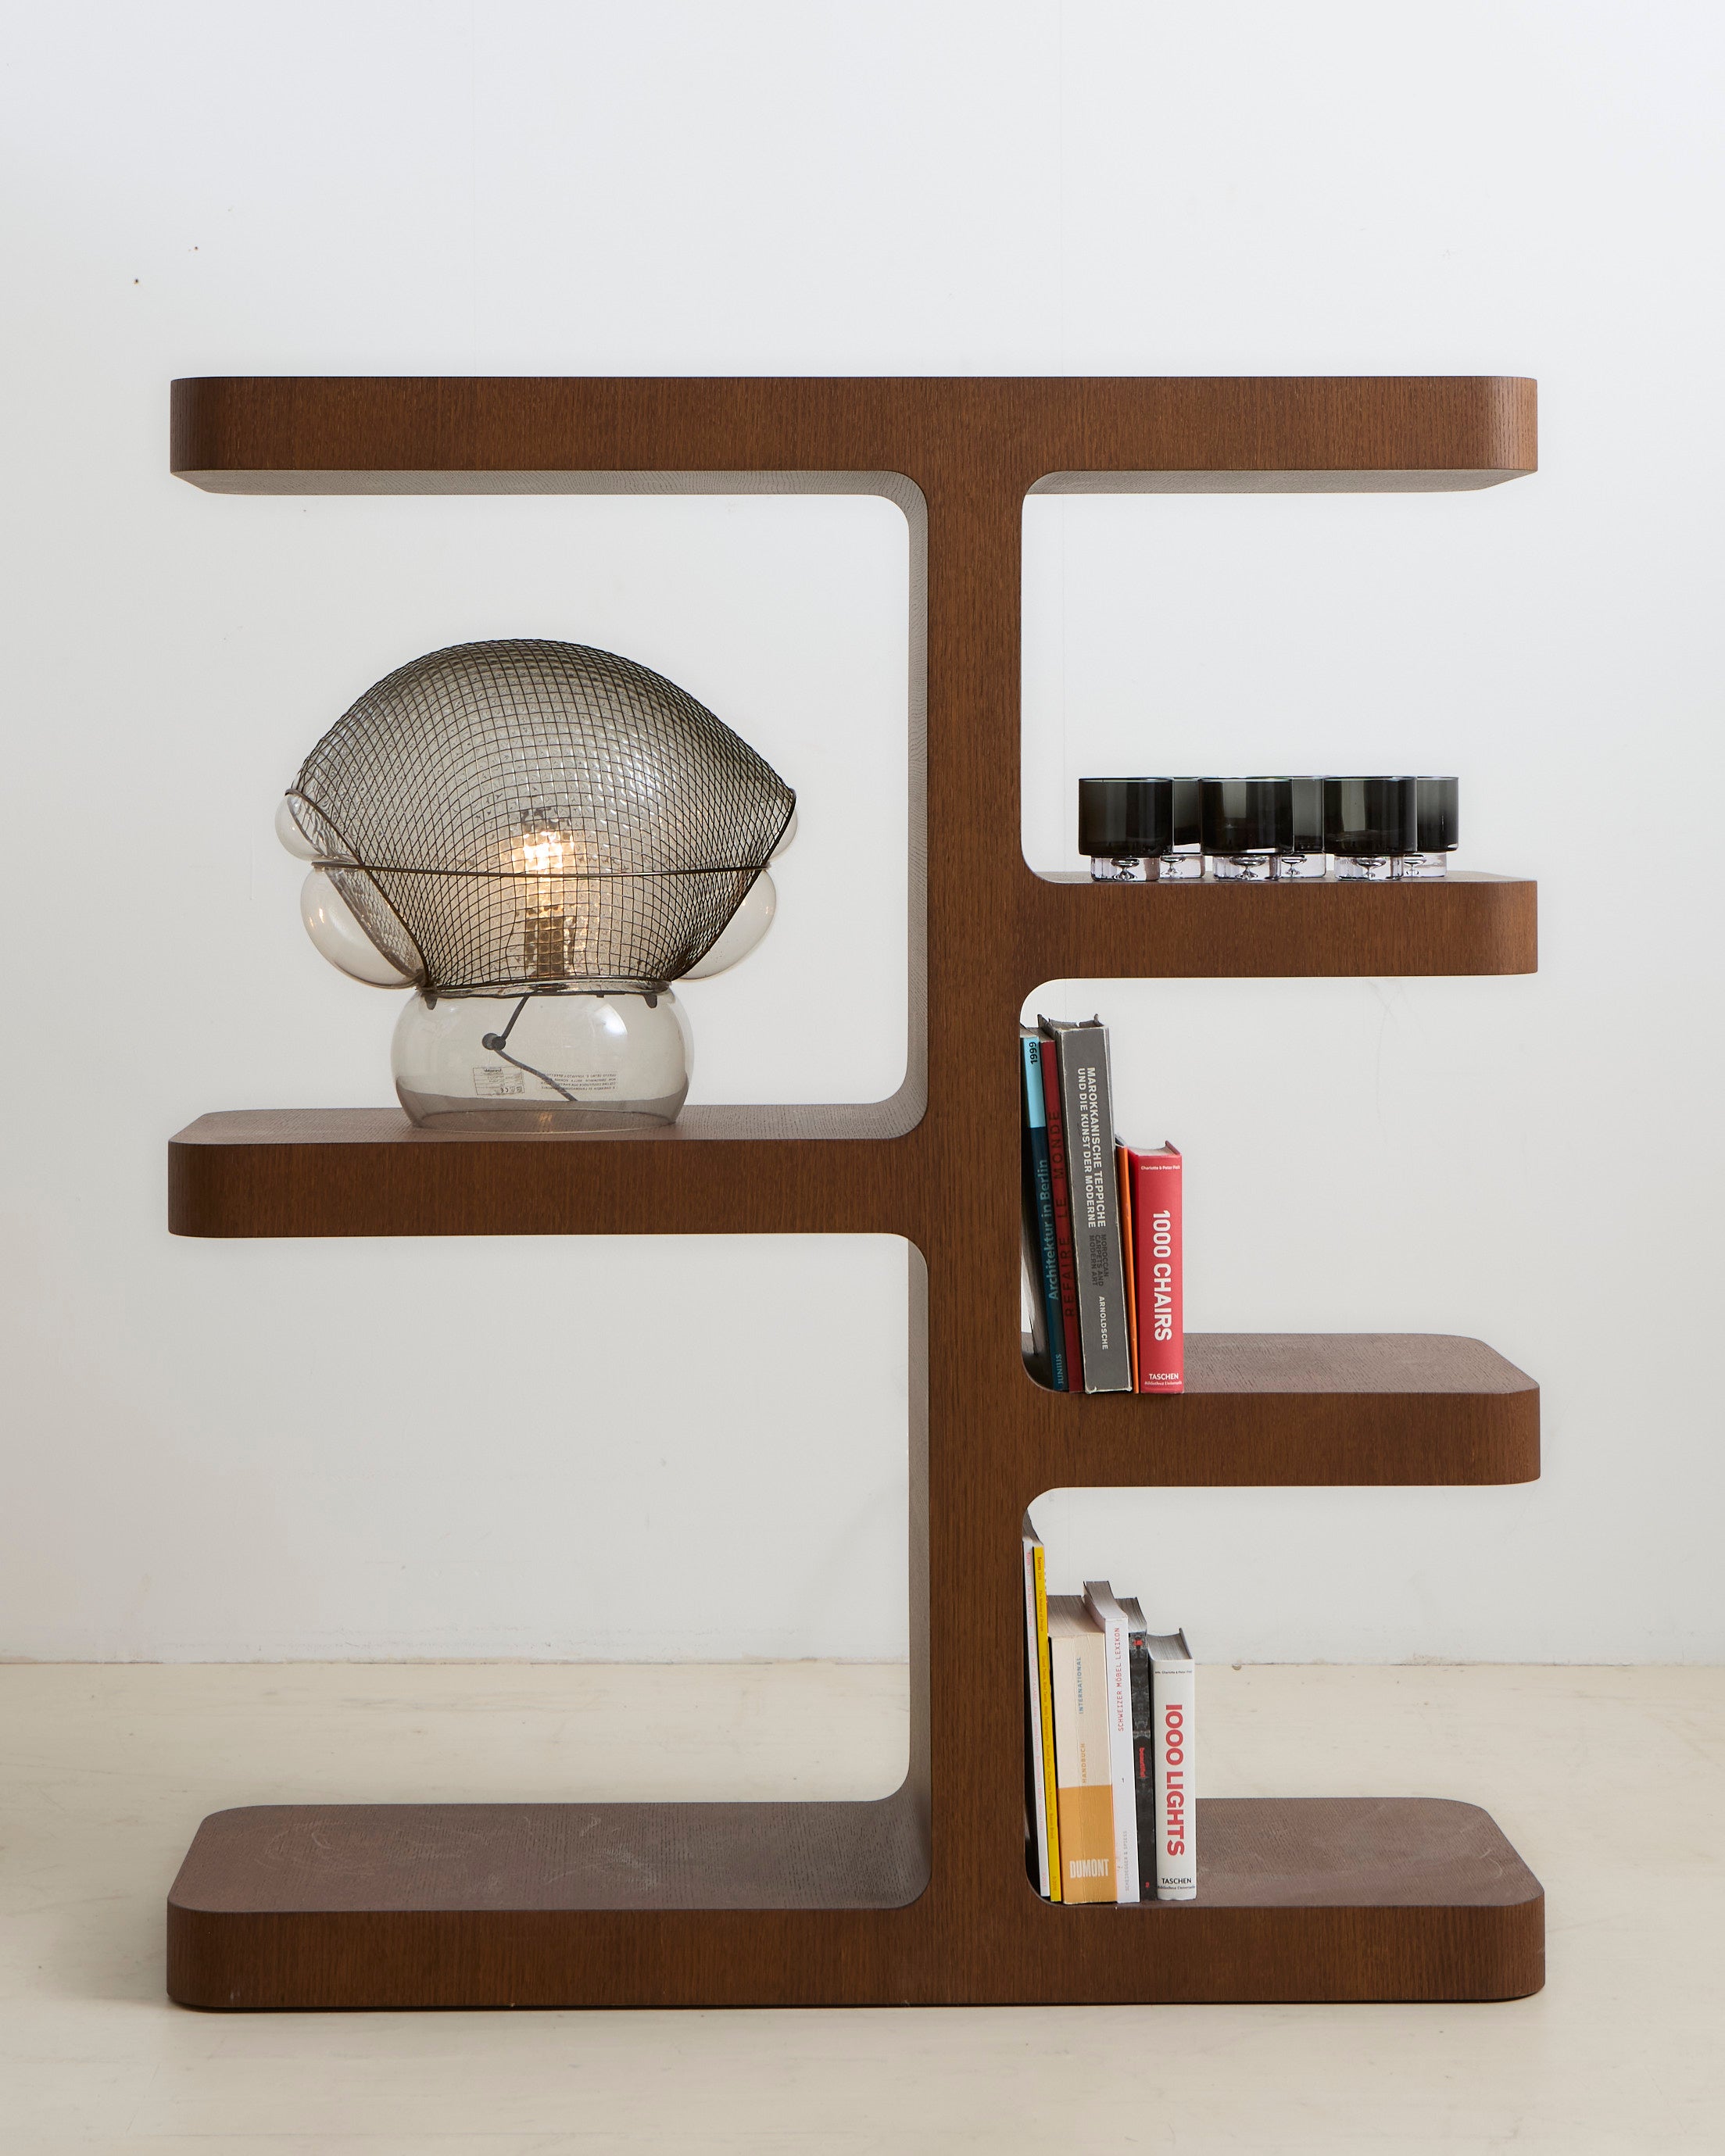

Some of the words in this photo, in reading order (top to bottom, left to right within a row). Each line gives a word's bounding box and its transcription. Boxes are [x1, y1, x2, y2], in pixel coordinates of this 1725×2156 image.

[1050, 1112, 1064, 1180] MONDE
[1081, 1114, 1090, 1149] KUNST
[1087, 1067, 1102, 1168] MAROKKANISCHE
[1096, 1171, 1106, 1227] TEPPICHE
[1038, 1160, 1050, 1201] Berlin
[1083, 1152, 1092, 1173] DER
[1042, 1205, 1051, 1217] in
[1057, 1199, 1067, 1218] LE
[1085, 1175, 1096, 1228] MODERNE
[1044, 1221, 1059, 1300] Architektur
[1153, 1210, 1171, 1258] 1000
[1059, 1237, 1074, 1318] REFAIRE
[1154, 1263, 1172, 1341] CHAIRS
[1098, 1296, 1108, 1350] ARNOLDSCHE
[1165, 1704, 1184, 1765] 1000
[1166, 1772, 1184, 1856] LIGHTS
[1070, 1859, 1109, 1878] DUMONT
